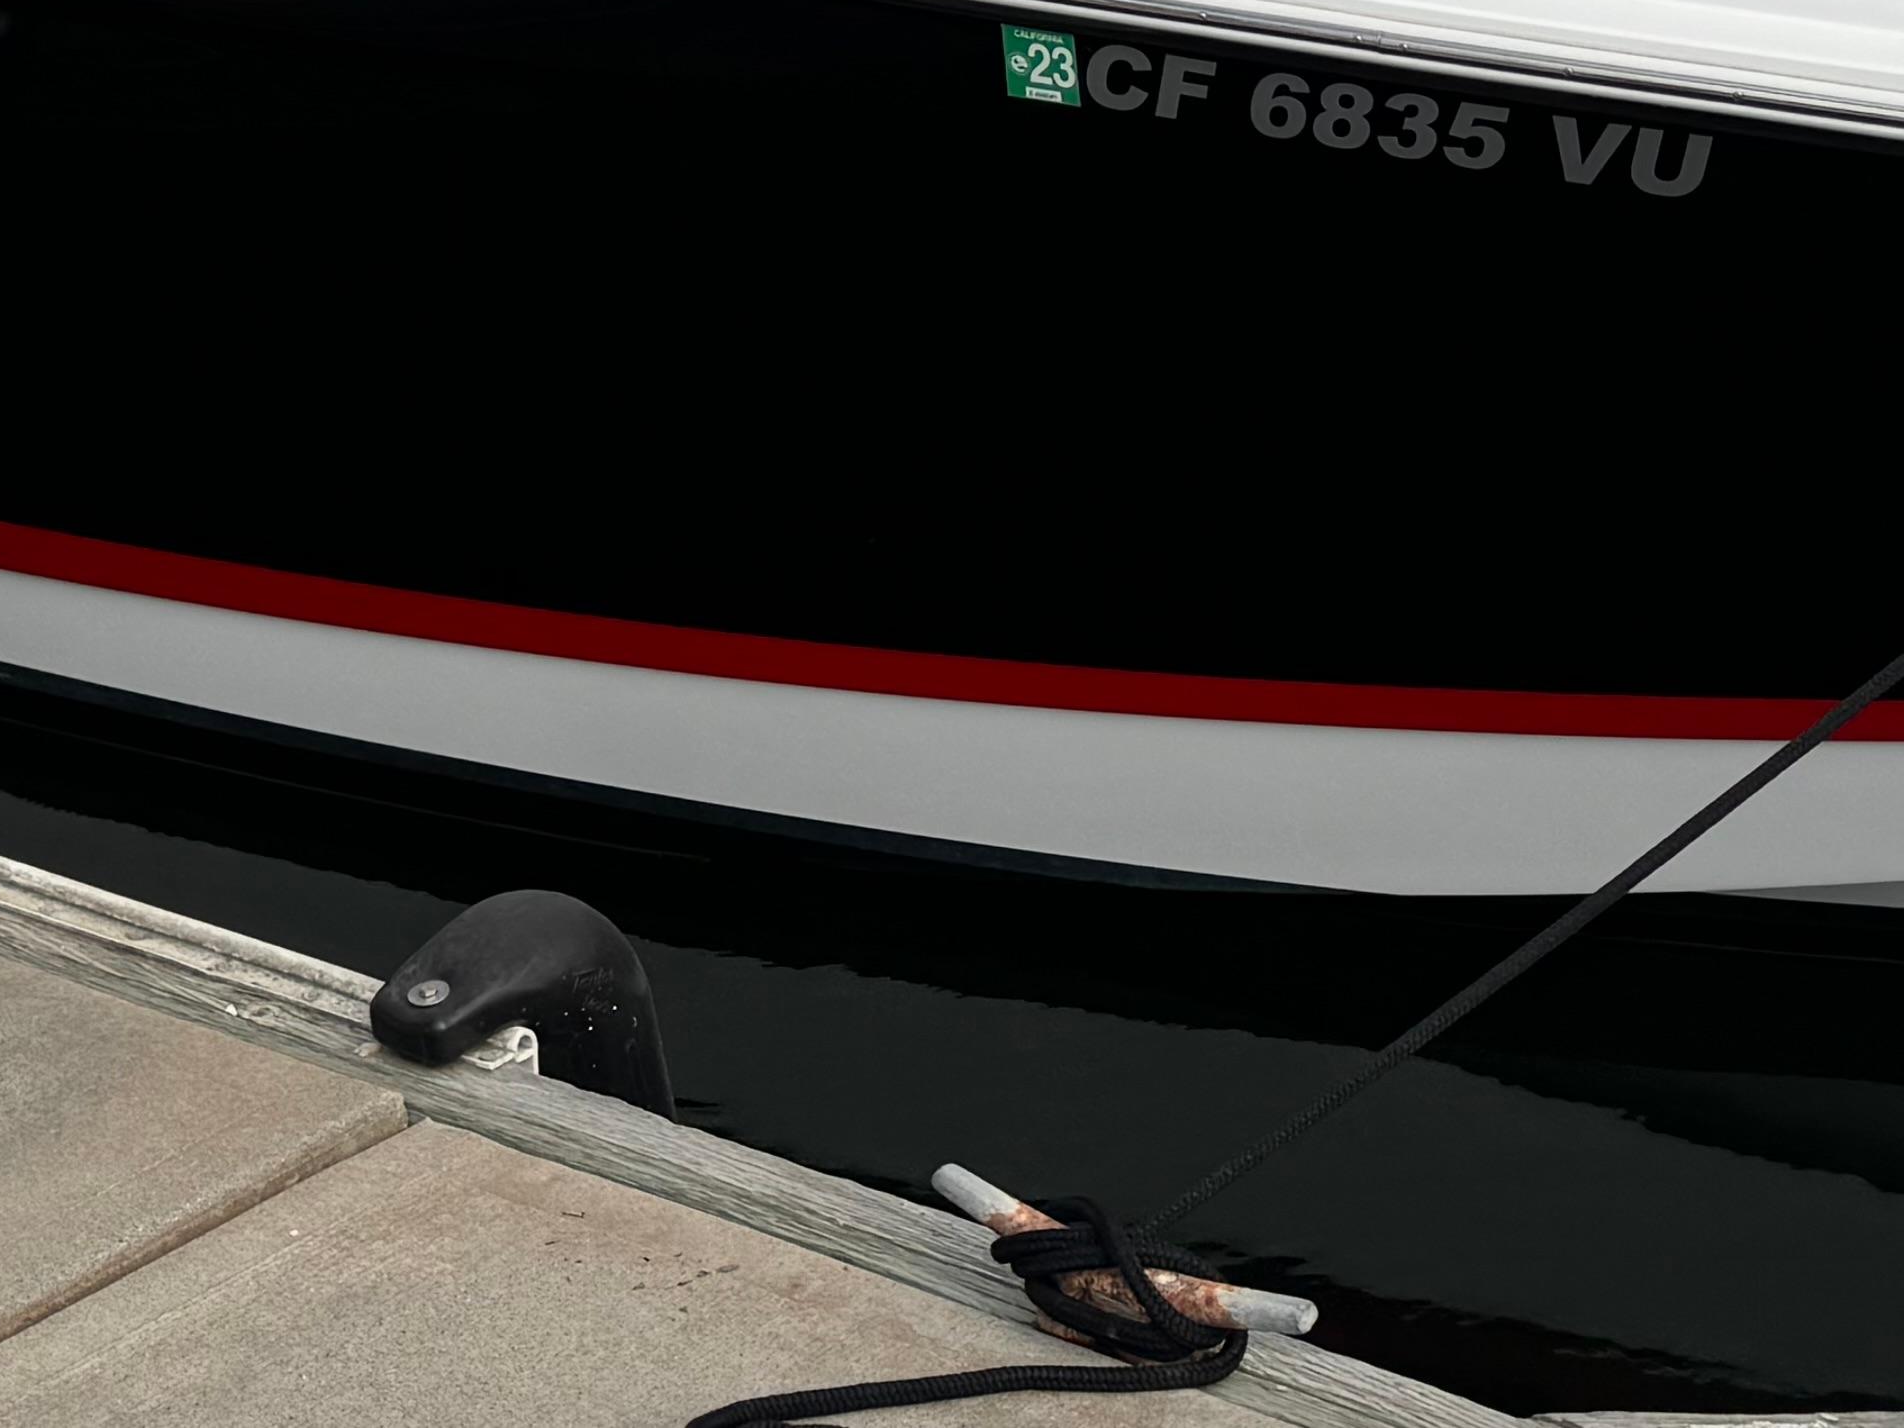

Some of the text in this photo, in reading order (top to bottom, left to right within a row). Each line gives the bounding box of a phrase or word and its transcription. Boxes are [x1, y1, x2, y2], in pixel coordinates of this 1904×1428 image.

[1027, 42, 1076, 89] 23
[1085, 44, 1714, 198] CF 6835 VU
